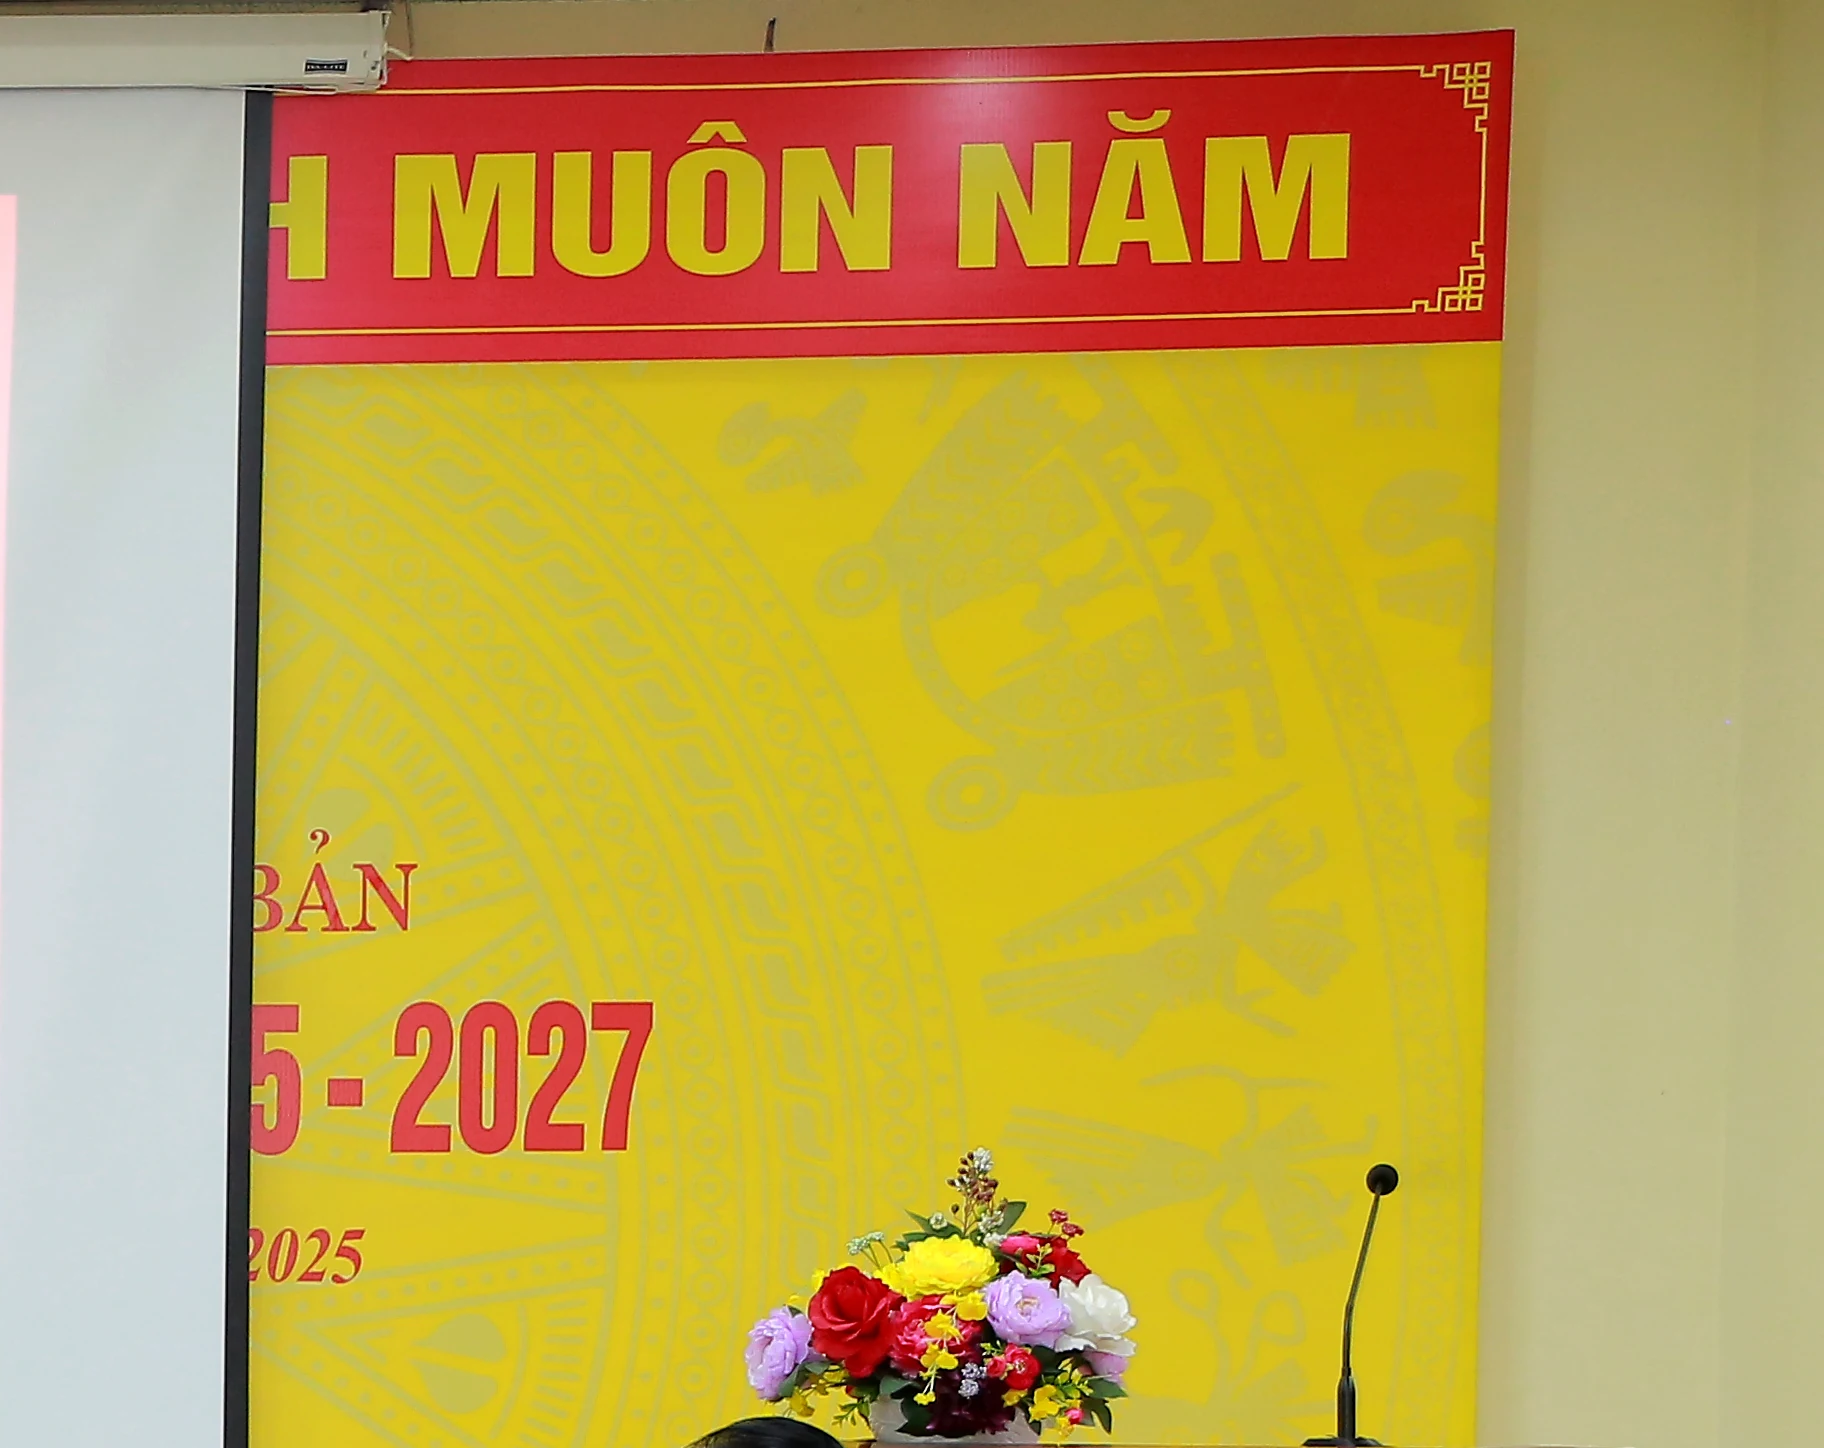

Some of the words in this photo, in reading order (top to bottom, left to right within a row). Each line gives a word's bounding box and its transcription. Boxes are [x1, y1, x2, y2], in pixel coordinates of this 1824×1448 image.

[393, 121, 893, 278] MUÔN
[957, 110, 1351, 268] NĂM
[390, 1000, 654, 1154] 2027
